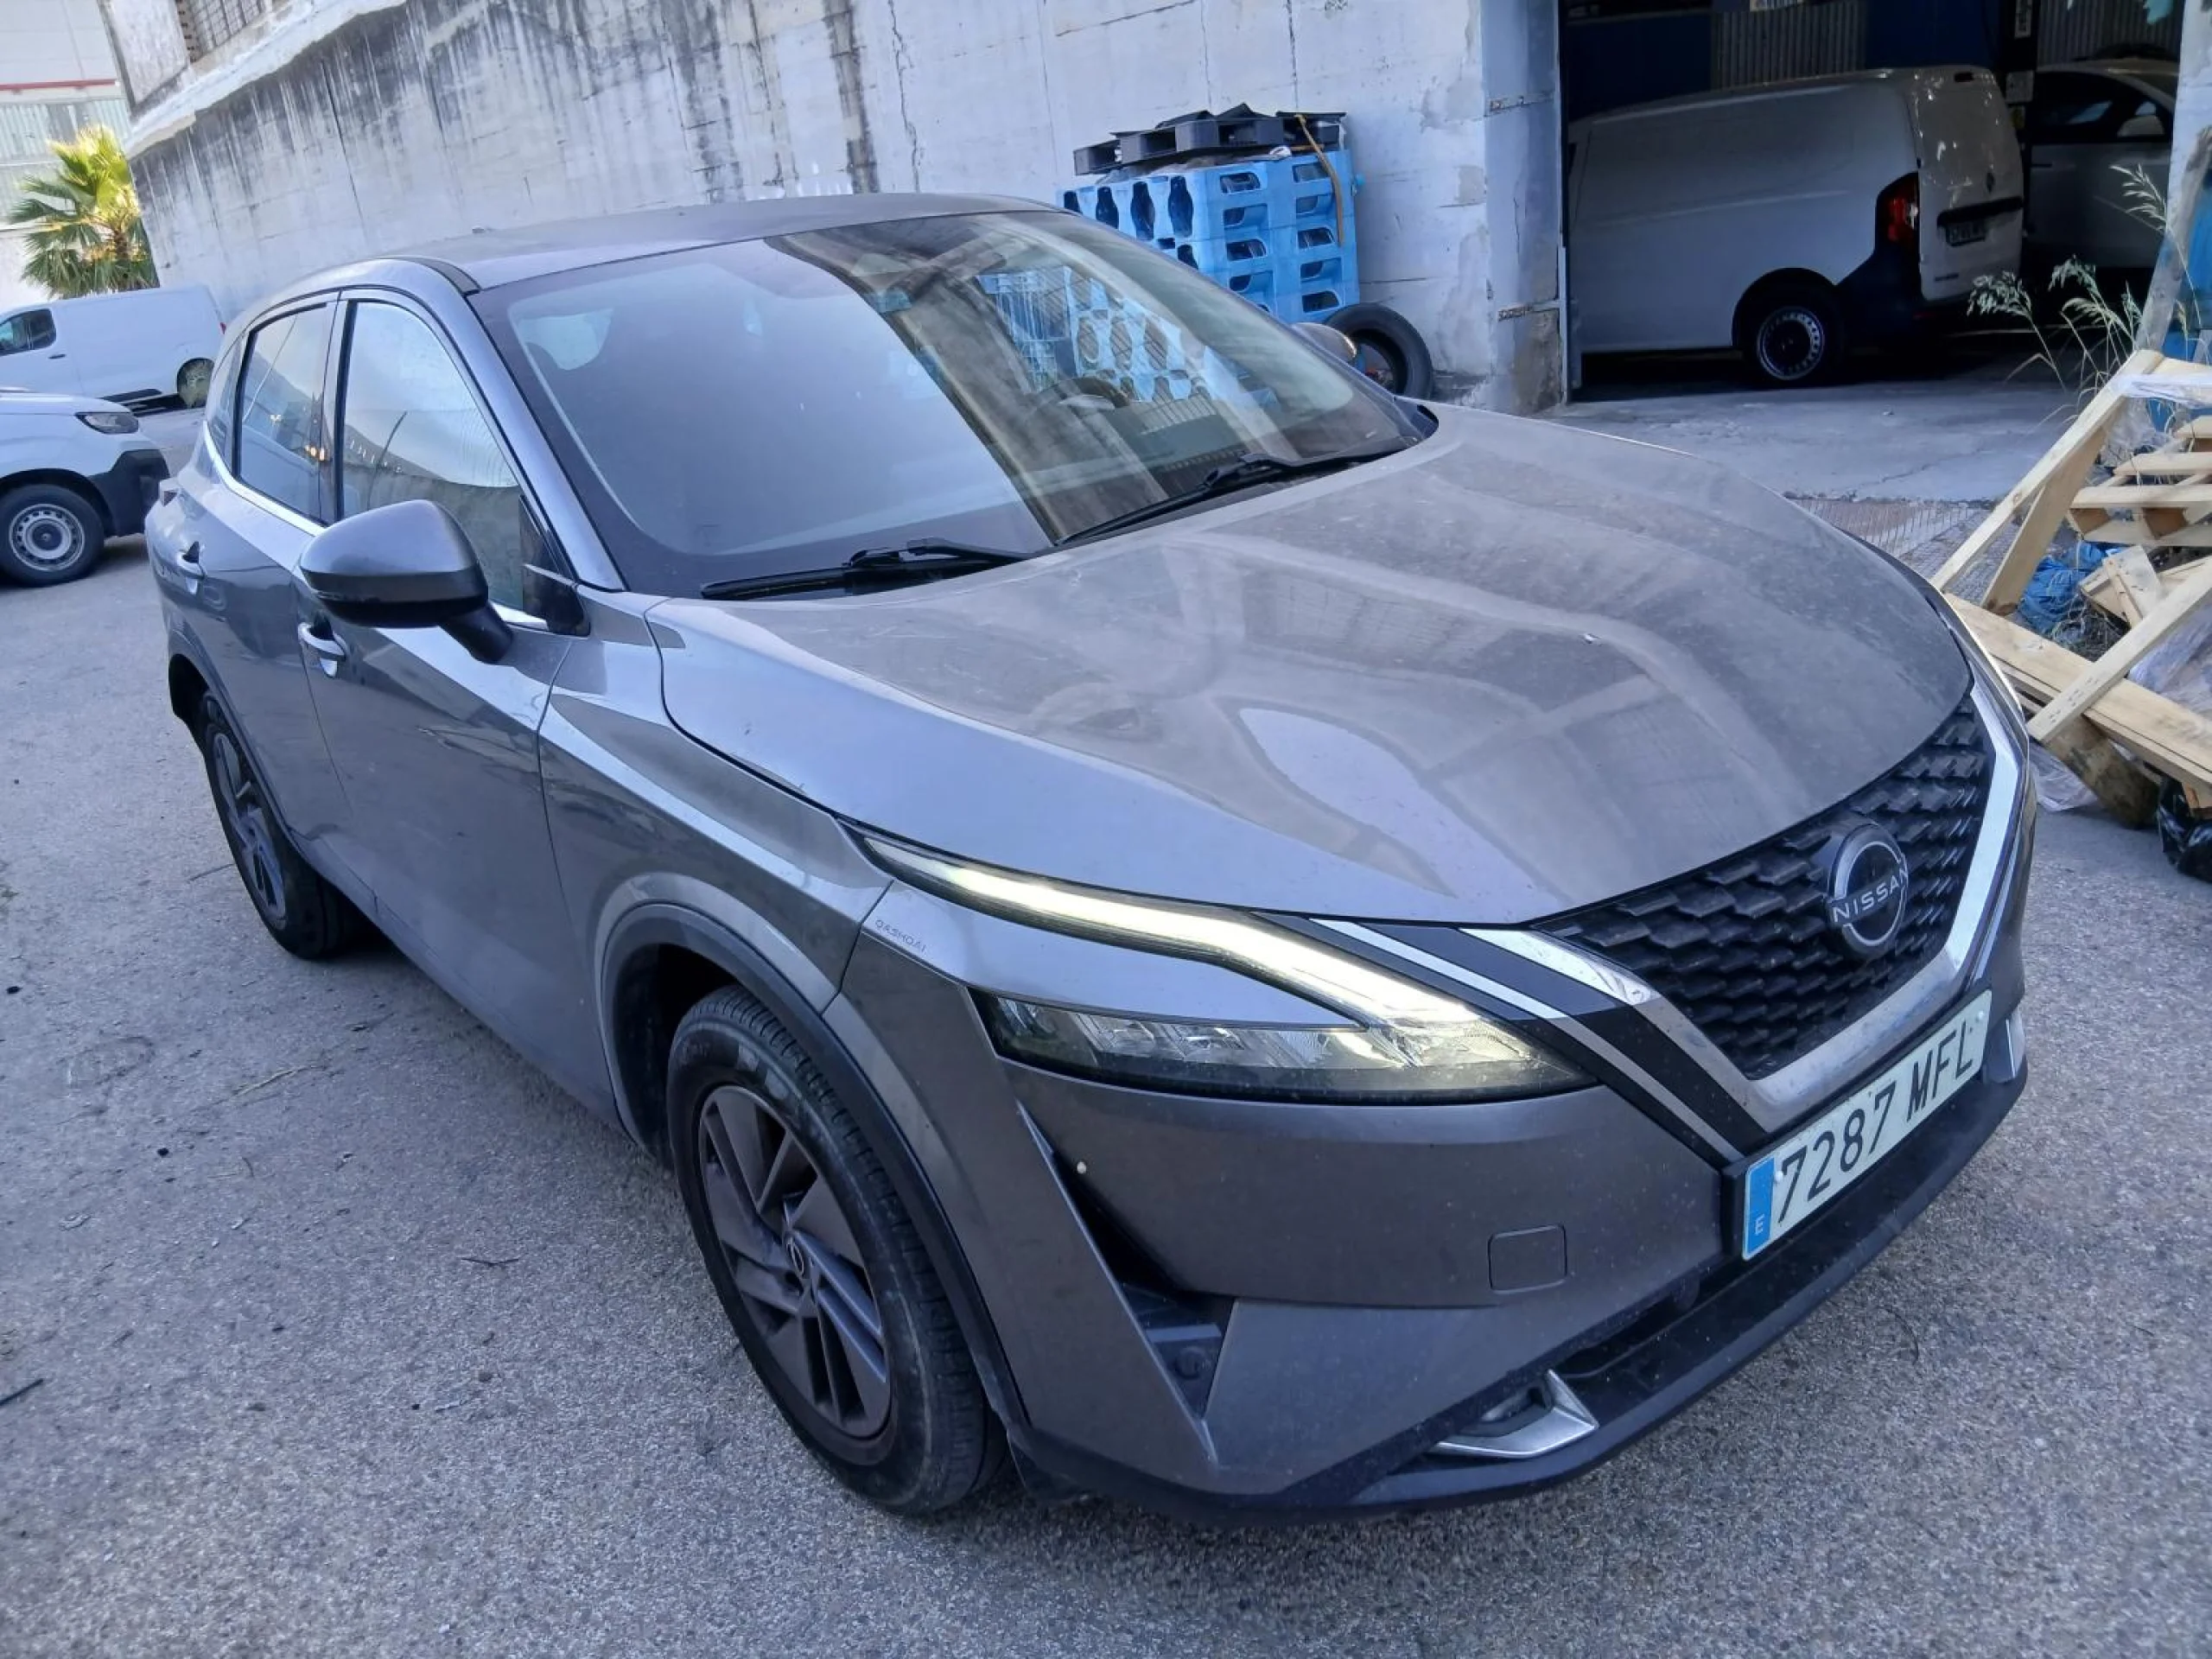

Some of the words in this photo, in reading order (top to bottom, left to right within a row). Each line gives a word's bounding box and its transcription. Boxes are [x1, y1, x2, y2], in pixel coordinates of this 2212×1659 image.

[1834, 868, 1909, 923] NISSAN
[1777, 1081, 1897, 1224] 7287
[1906, 1020, 1973, 1122] MFL
[1754, 1213, 1764, 1236] E
